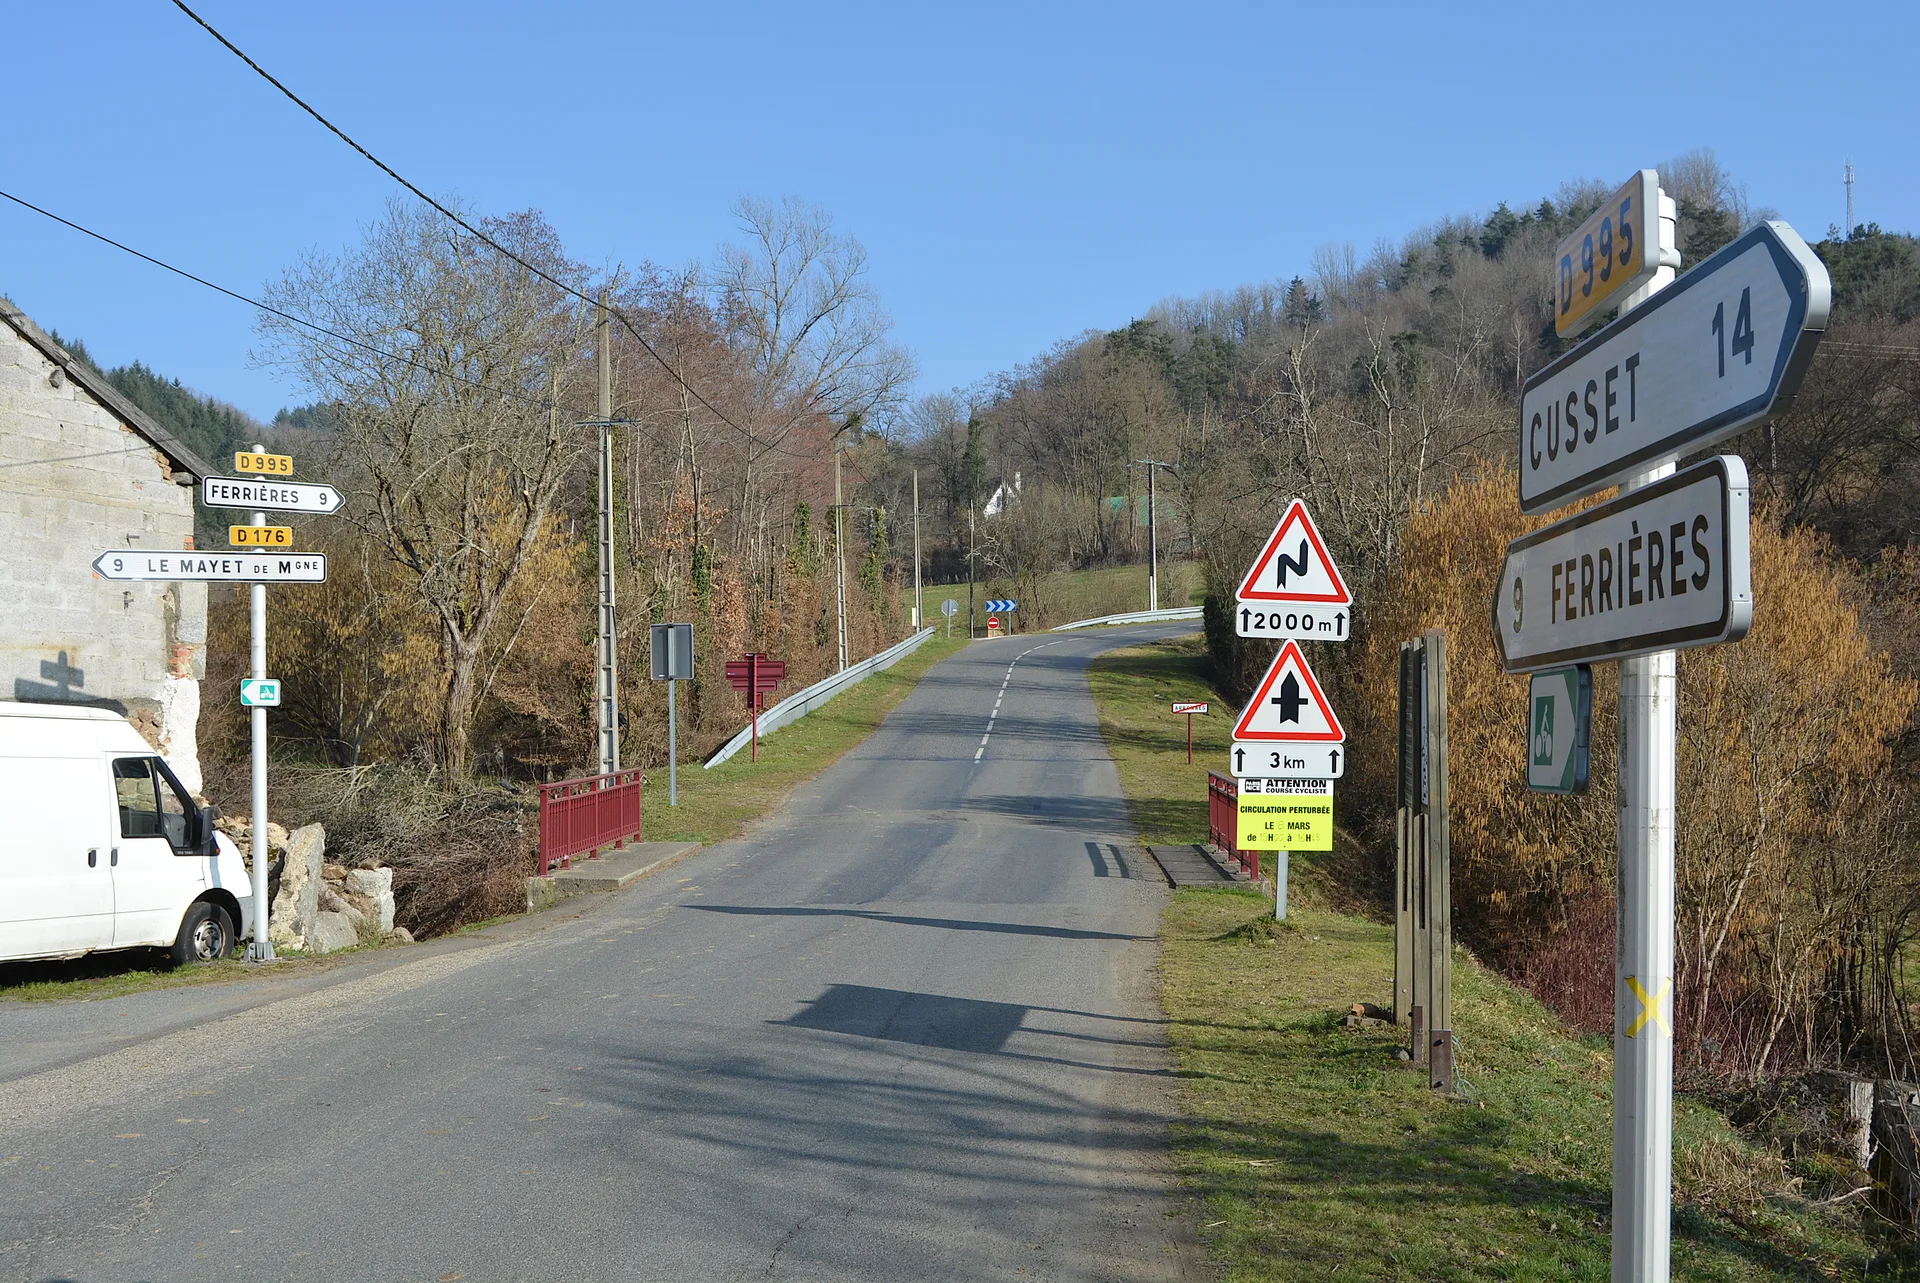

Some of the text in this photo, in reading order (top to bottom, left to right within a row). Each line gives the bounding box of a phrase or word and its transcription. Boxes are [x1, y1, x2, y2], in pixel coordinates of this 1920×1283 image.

[1559, 195, 1634, 316] D 995
[1529, 285, 1755, 471] CUSSET 14
[241, 455, 288, 471] D 995
[211, 484, 327, 505] FERRIÈRES 9
[238, 529, 285, 543] D 176
[113, 558, 124, 572] 9
[148, 559, 169, 572] LE
[180, 559, 243, 574] MAYET
[253, 565, 268, 574] DE
[1511, 514, 1711, 633] 9 FERRIÈRES
[1254, 612, 1332, 631] 2000 m
[1270, 752, 1305, 769] 3 km
[1266, 779, 1327, 788] ATTENTION
[1240, 805, 1330, 814] CIRCULATION PERTURBÉE
[1264, 821, 1275, 830] LE
[1287, 821, 1311, 830] MARS
[1247, 833, 1257, 842] de
[1287, 833, 1292, 842] à
